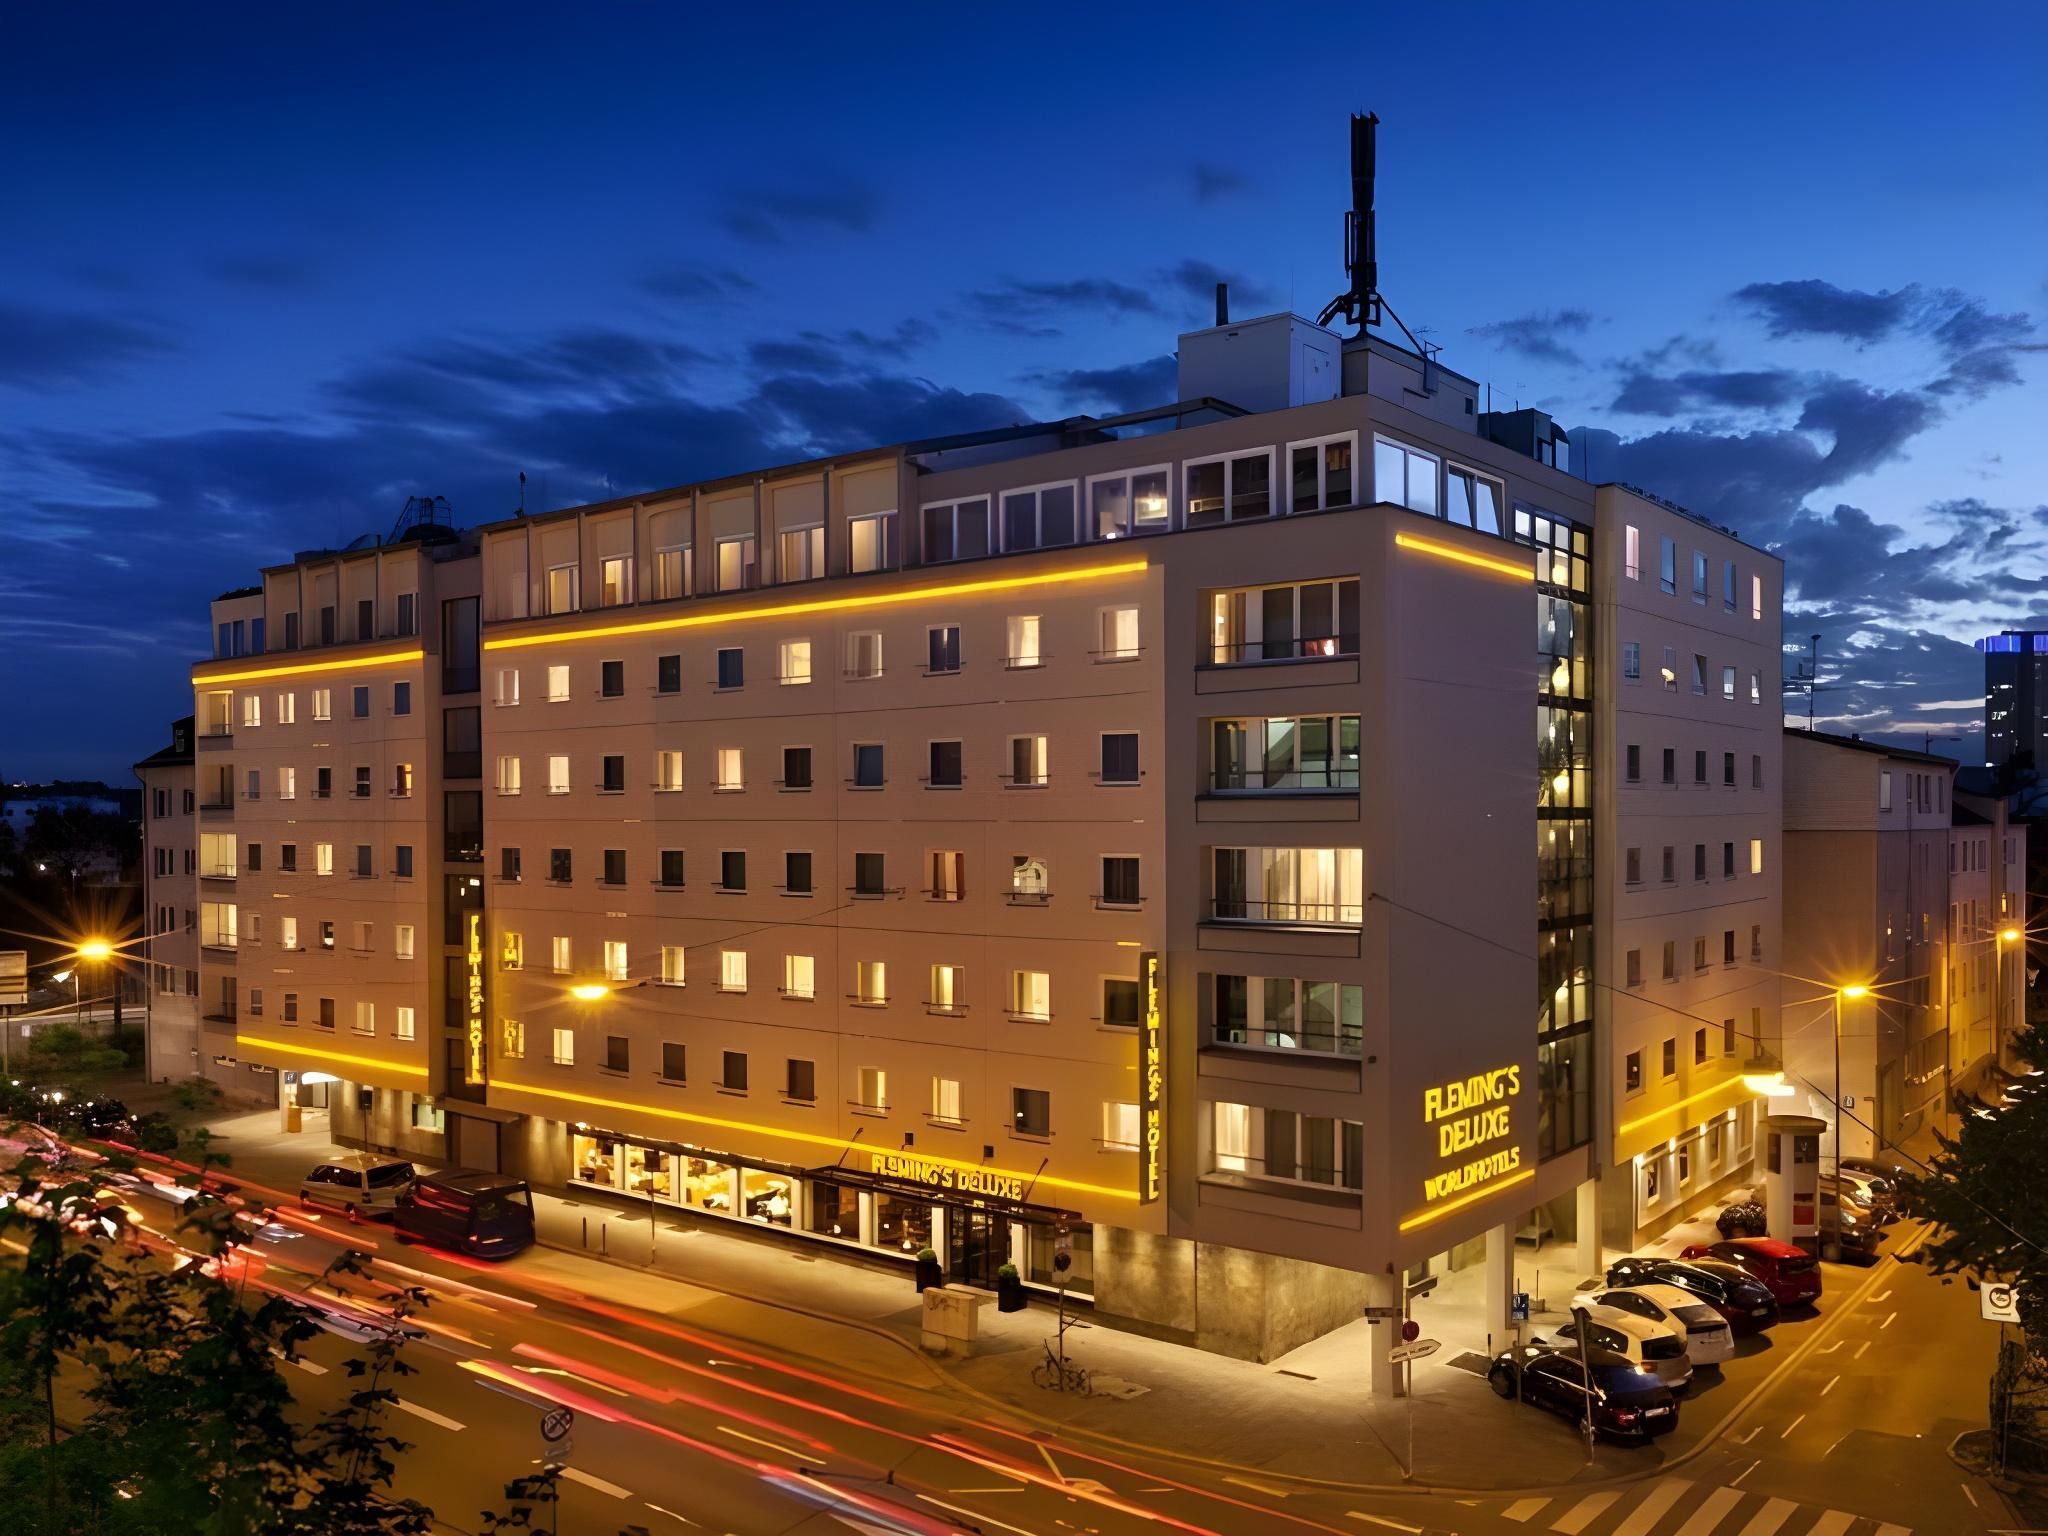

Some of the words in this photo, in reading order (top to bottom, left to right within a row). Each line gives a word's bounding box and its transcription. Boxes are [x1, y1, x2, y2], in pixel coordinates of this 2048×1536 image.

[1424, 1064, 1520, 1123] FLEMING'S
[1439, 1105, 1511, 1158] DELUXE
[957, 1170, 1023, 1201] DELUXE
